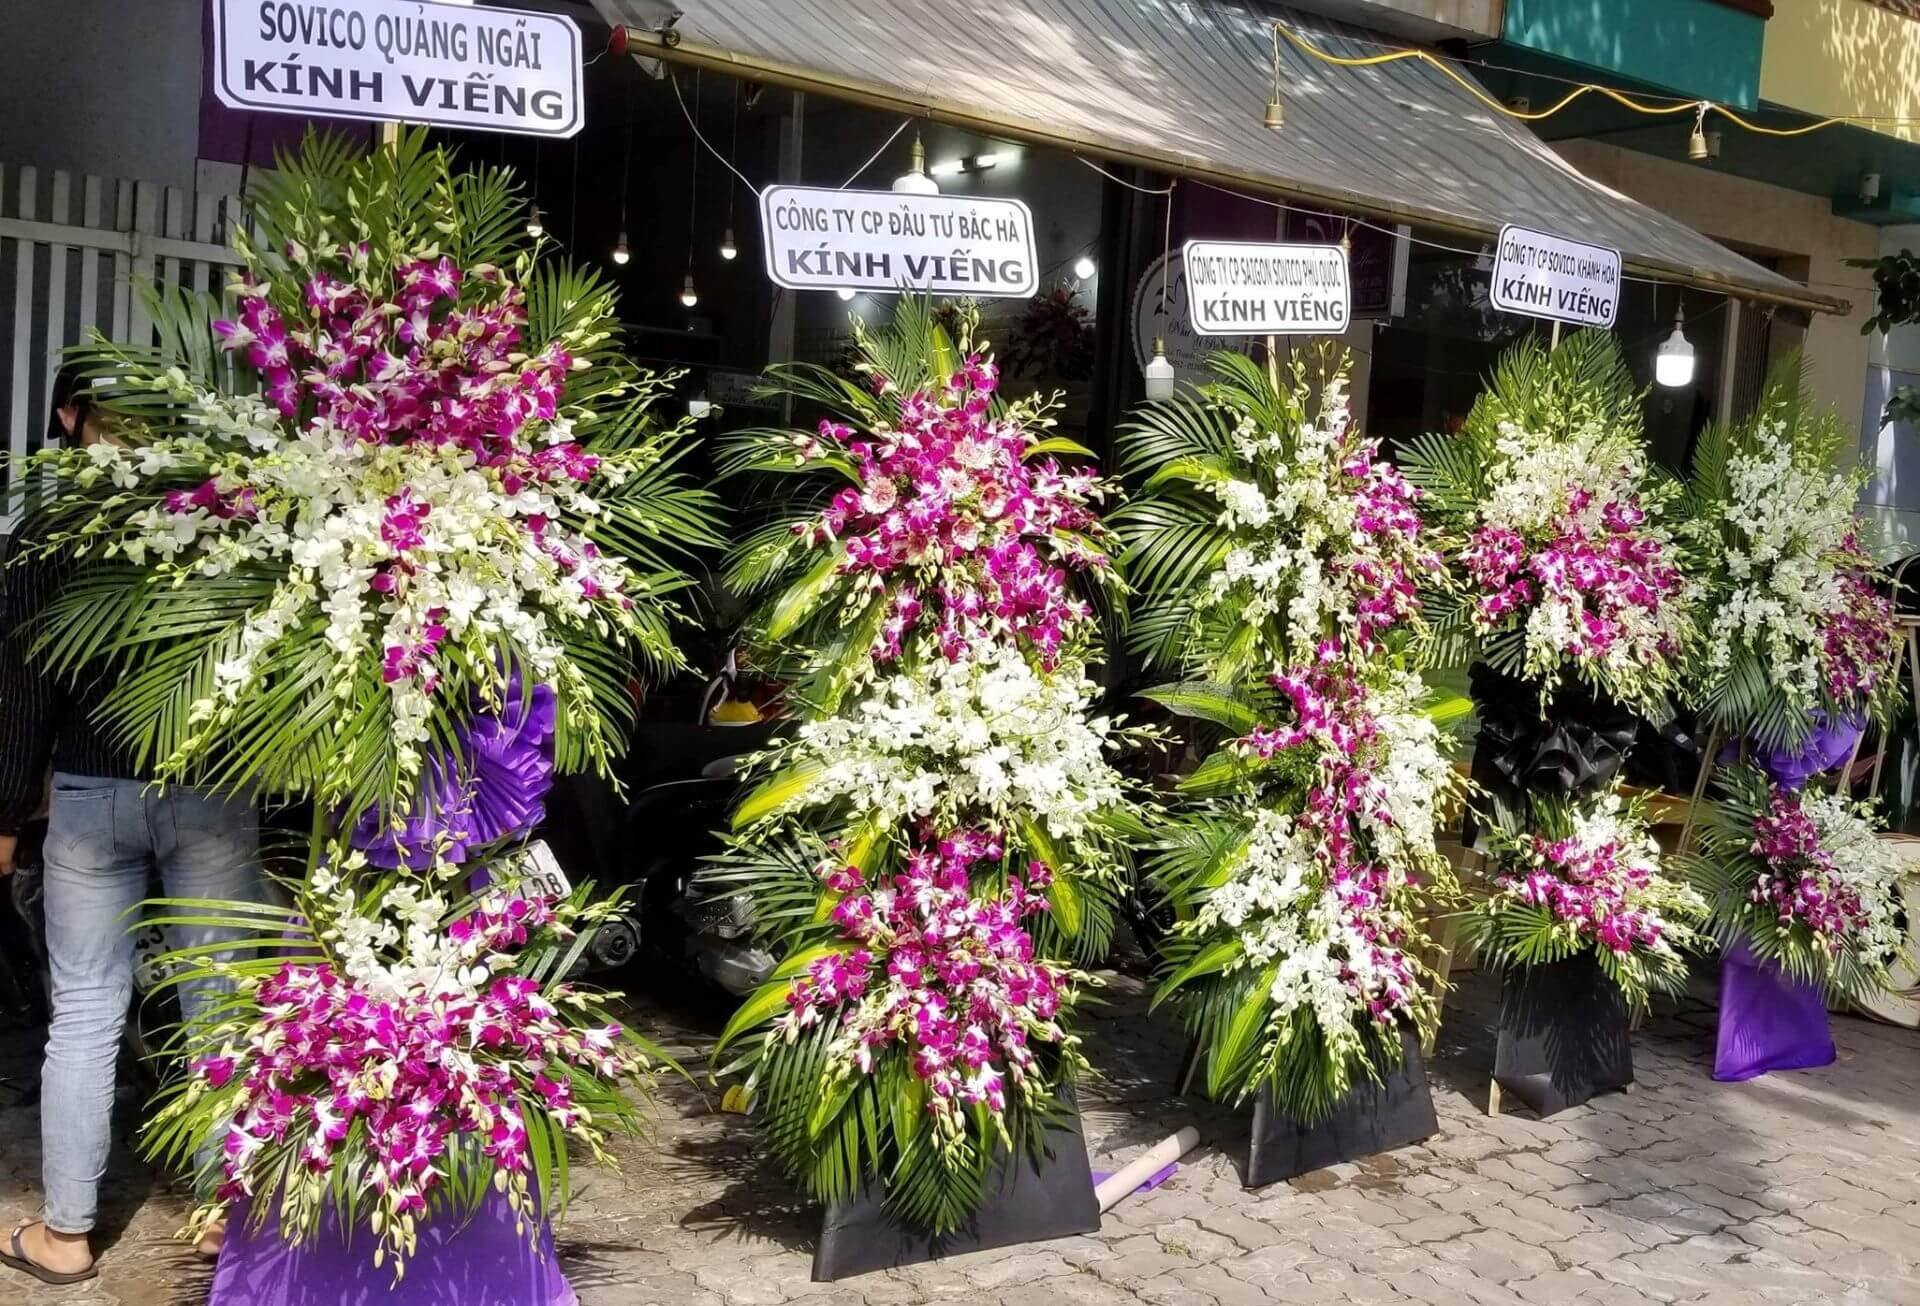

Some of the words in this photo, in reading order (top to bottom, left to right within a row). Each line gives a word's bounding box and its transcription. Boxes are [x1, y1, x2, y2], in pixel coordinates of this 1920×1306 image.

[260, 1, 366, 51] SOVICO
[375, 7, 468, 64] QUẢNG
[477, 19, 542, 70] NGÃI
[244, 53, 384, 103] KÍNH
[402, 72, 564, 120] VIẾNG
[776, 198, 828, 232] CÔNG
[832, 209, 855, 233] TY
[861, 209, 884, 235] CP
[888, 204, 926, 237] ĐẦU
[930, 211, 955, 239] TƯ
[959, 208, 992, 241] BẮC
[996, 212, 1020, 243] HÀ
[788, 242, 892, 279] KÍNH
[903, 248, 1024, 284] VIẾNG
[1192, 246, 1217, 285] CÔNG
[1215, 256, 1228, 286] TY
[1229, 256, 1240, 286] CP
[1241, 257, 1273, 287] SAIGON
[1273, 258, 1303, 287] SOVICO
[1319, 251, 1341, 294] QUỐC
[1502, 236, 1526, 265] CÔNG
[1528, 246, 1538, 267] TY
[1537, 249, 1548, 269] CP
[1548, 252, 1576, 277] SOVICO
[1577, 254, 1601, 283] KHÁNH
[1203, 291, 1266, 322] KÍNH
[1274, 292, 1343, 322] VIẾNG
[1502, 274, 1551, 308] KÍNH
[1558, 287, 1612, 319] VIẾNG
